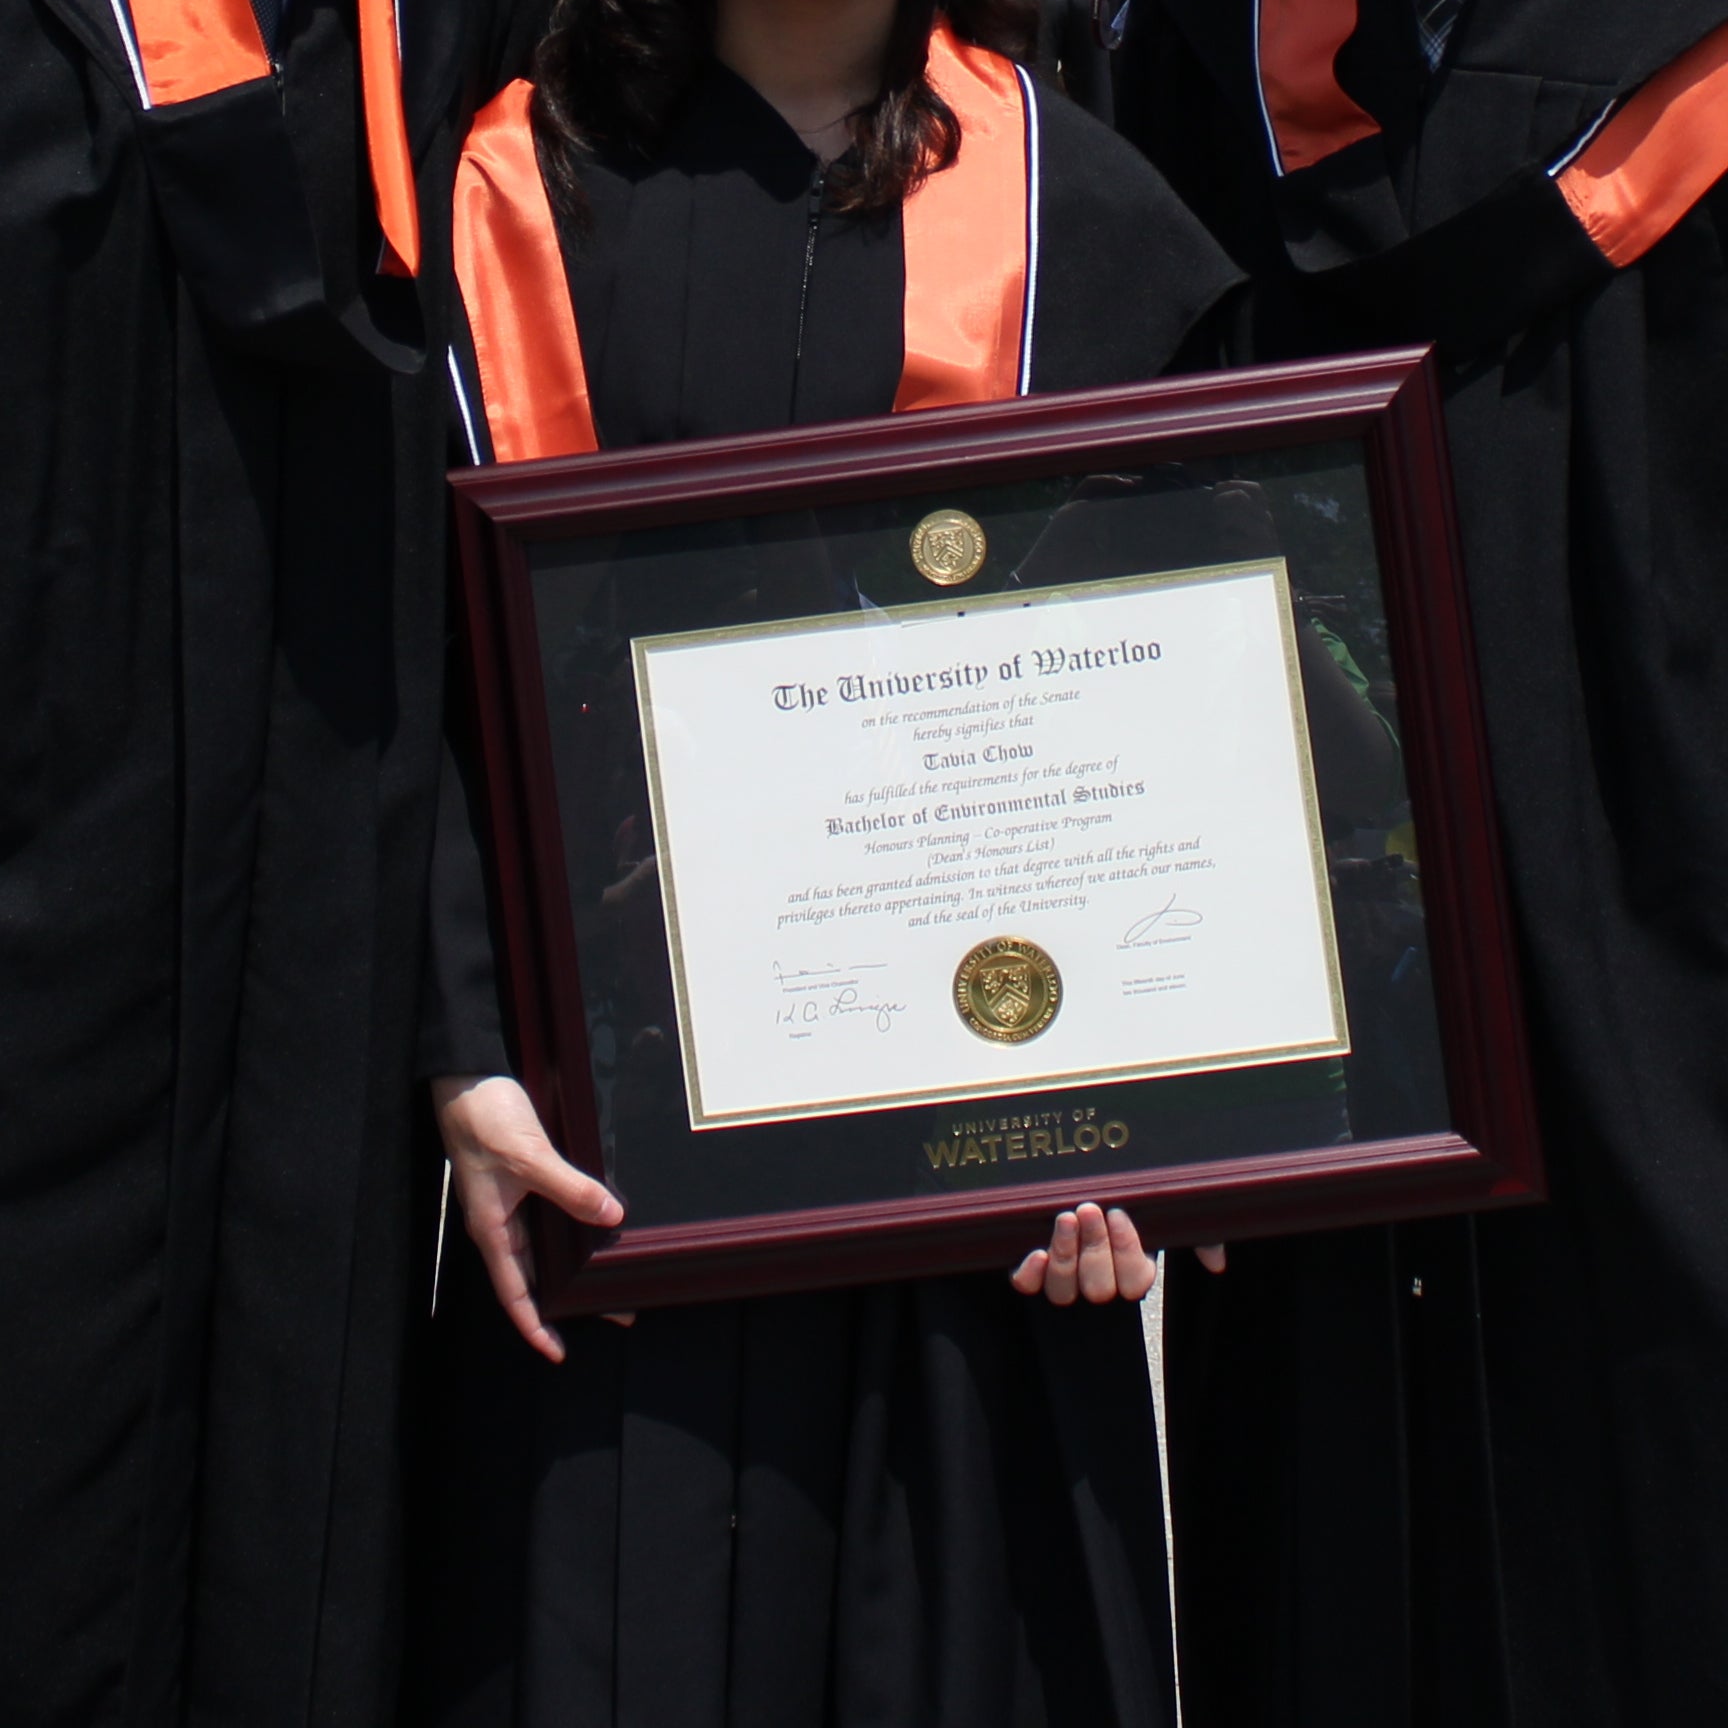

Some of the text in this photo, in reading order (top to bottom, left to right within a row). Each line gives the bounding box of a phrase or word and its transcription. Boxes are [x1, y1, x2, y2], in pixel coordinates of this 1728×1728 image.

[771, 640, 1161, 712] The University of Waterloo
[861, 688, 1080, 729] on the recommendation of the Senate
[913, 712, 1034, 744] hereby signifies that
[922, 743, 1033, 771] Tavia Chow
[844, 754, 1120, 807] has fulfilled the requirements for the degree of
[825, 780, 1145, 838] Bachelor of Environmental Studies
[864, 812, 1112, 855] Honours Planning Co-operative Program
[927, 833, 1055, 869] (Dean's Honours List)
[787, 835, 1201, 904] and has been granted admission to that degree with all the rights and
[777, 855, 1216, 930] privileges thereto appertaining. In witness whereof we attach our names,
[907, 891, 1089, 928] and the seal of the University.
[953, 1108, 1096, 1136] UNIVERSITY OF
[923, 1120, 1130, 1170] WATERLOO
